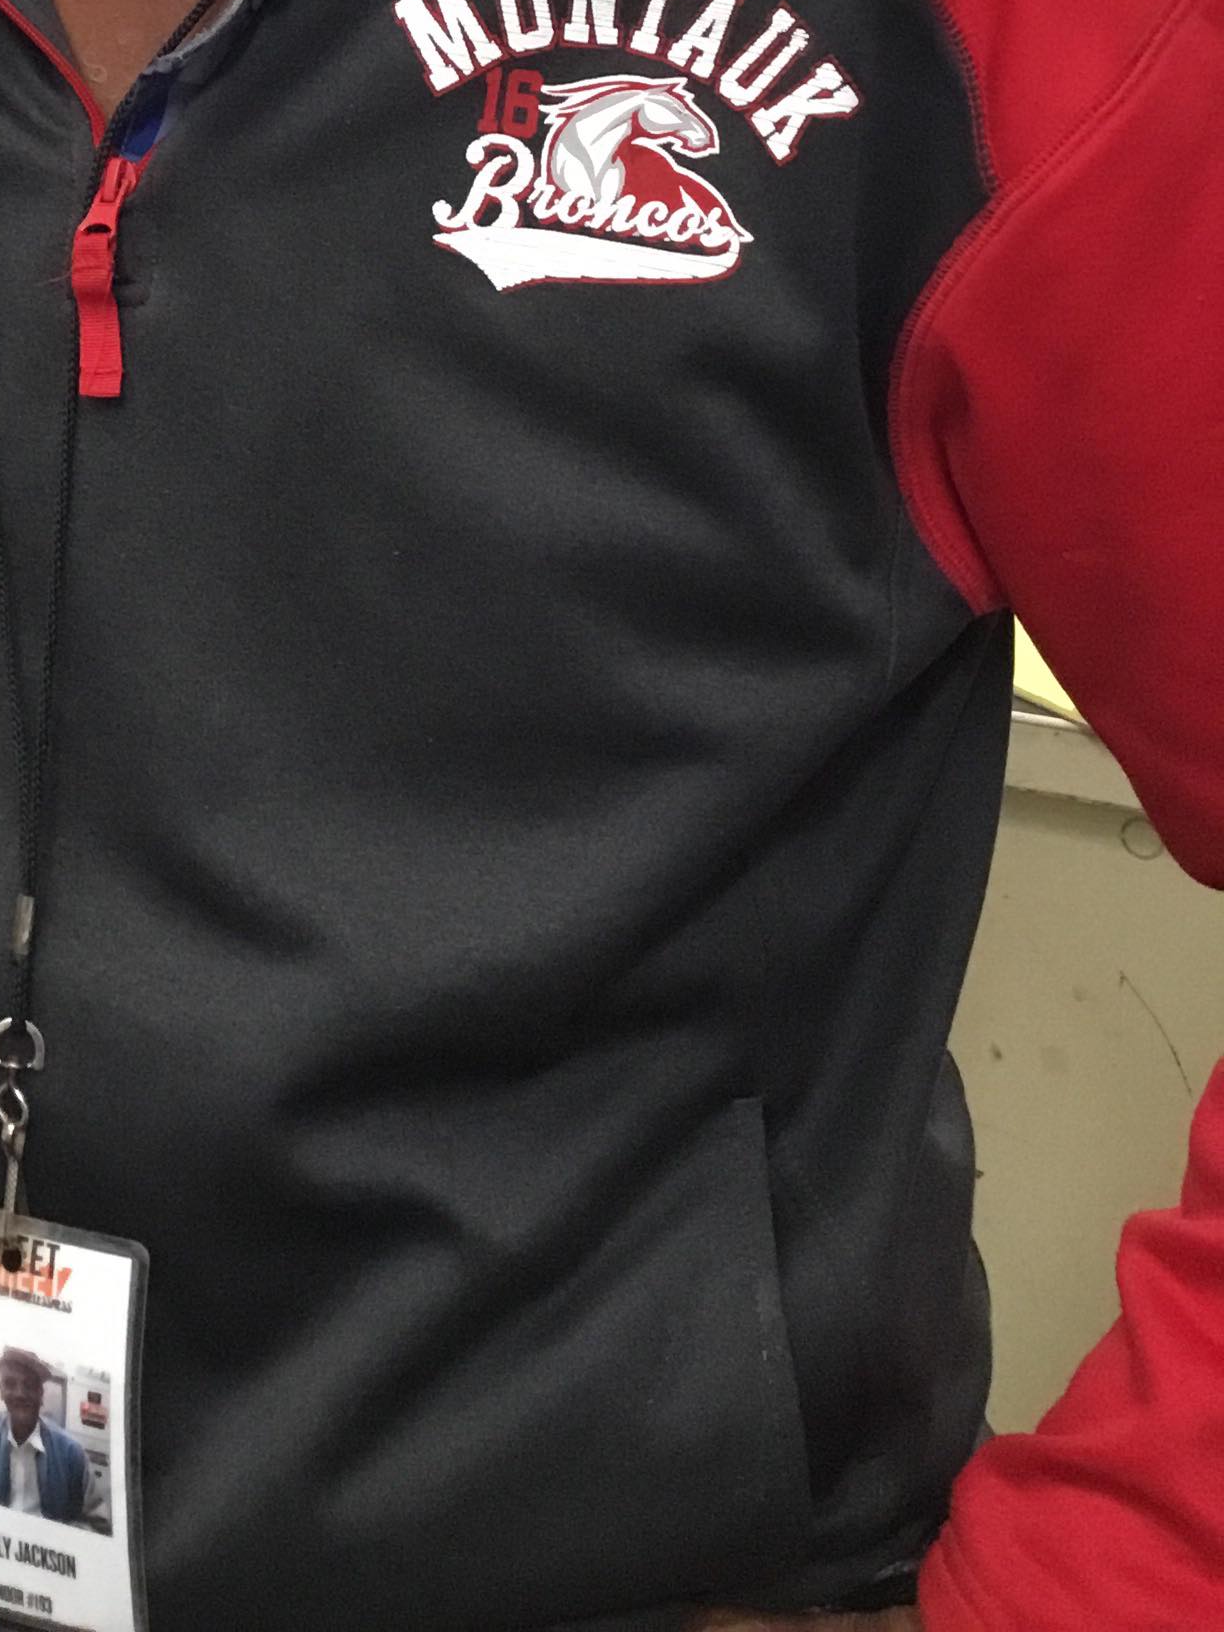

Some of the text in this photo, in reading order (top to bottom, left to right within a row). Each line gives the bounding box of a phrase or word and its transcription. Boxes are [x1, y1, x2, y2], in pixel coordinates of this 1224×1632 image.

[477, 67, 544, 138] 16
[432, 133, 733, 252] Broncos
[15, 1540, 76, 1579] JACKSON
